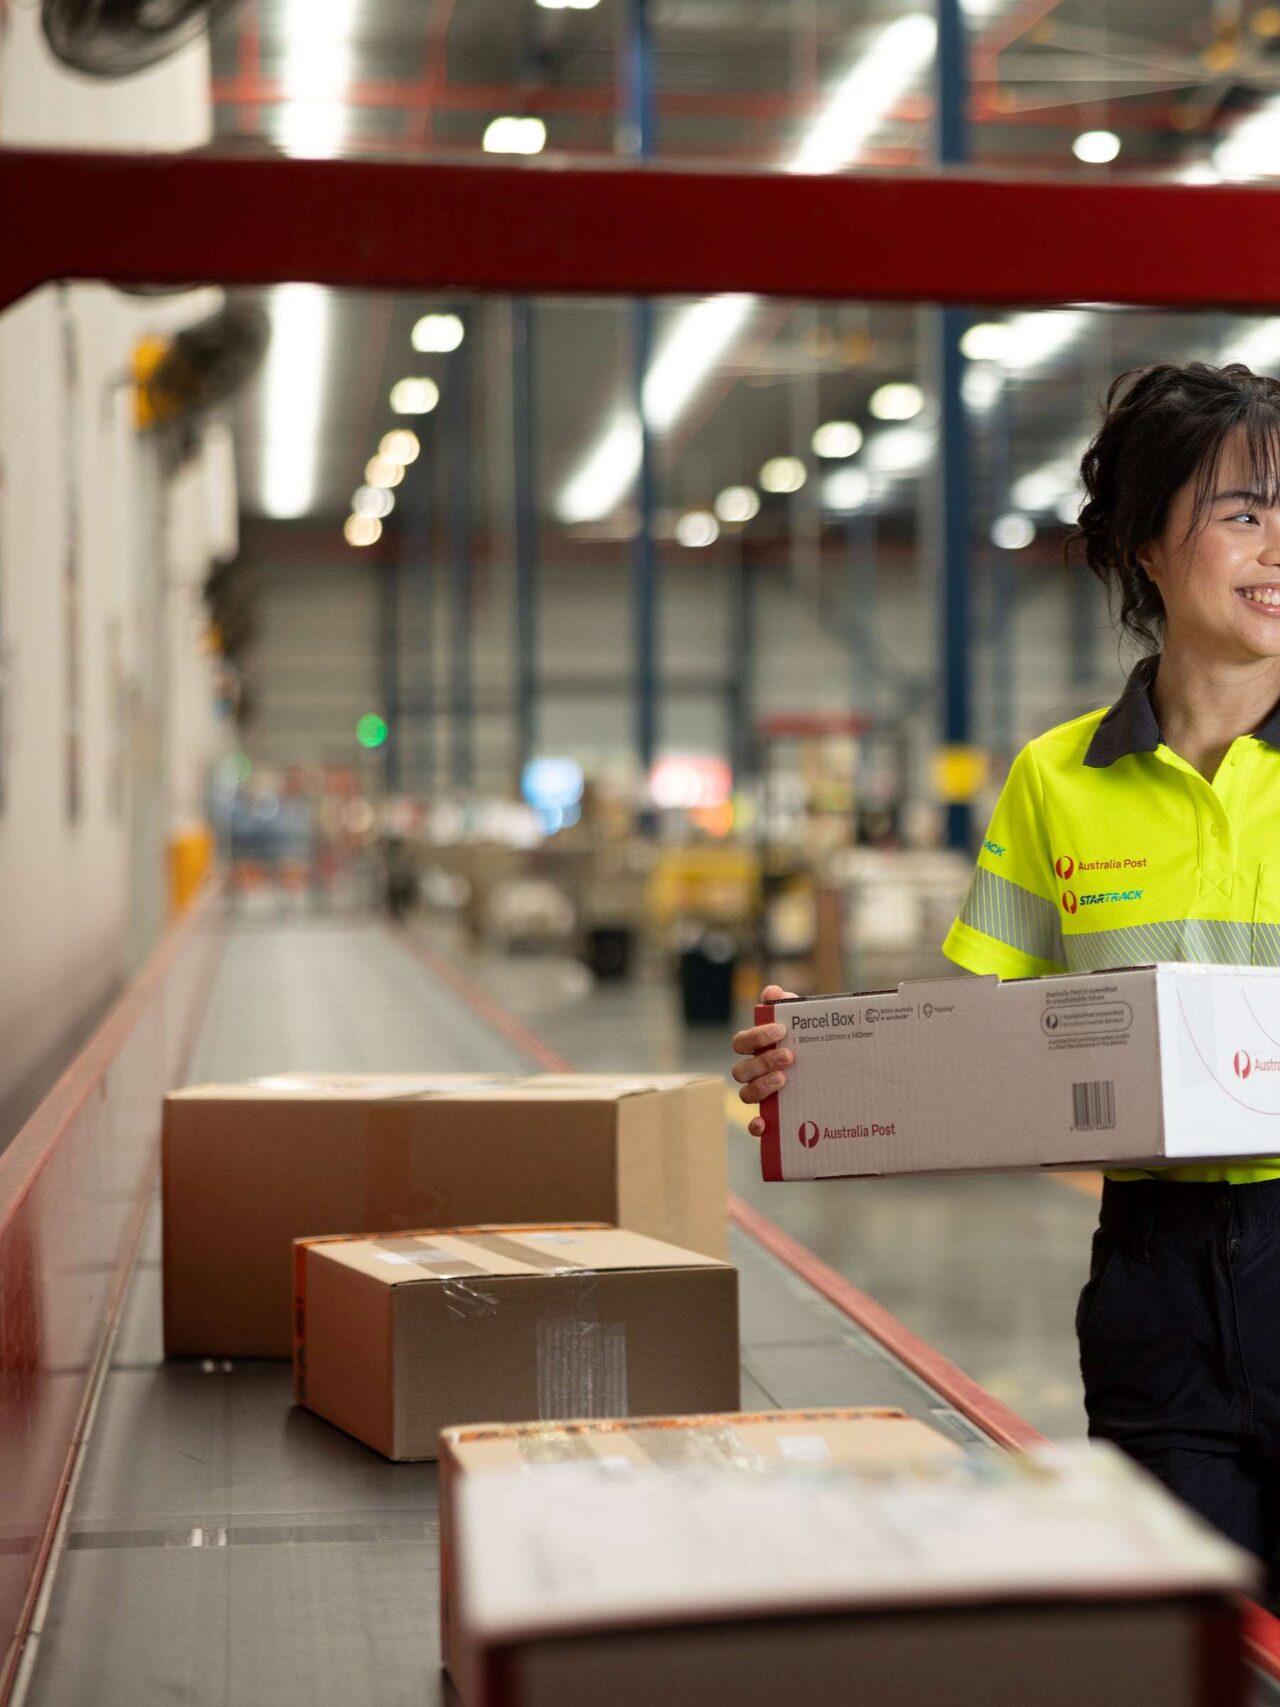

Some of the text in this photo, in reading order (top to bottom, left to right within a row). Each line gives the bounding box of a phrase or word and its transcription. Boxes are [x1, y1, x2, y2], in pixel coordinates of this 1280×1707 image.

[1078, 858, 1147, 871] Australia Post
[1079, 889, 1144, 906] STARTRACK
[792, 1012, 855, 1030] Parcel Box
[852, 1031, 874, 1040] 140mm
[823, 1122, 896, 1140] Australia Post
